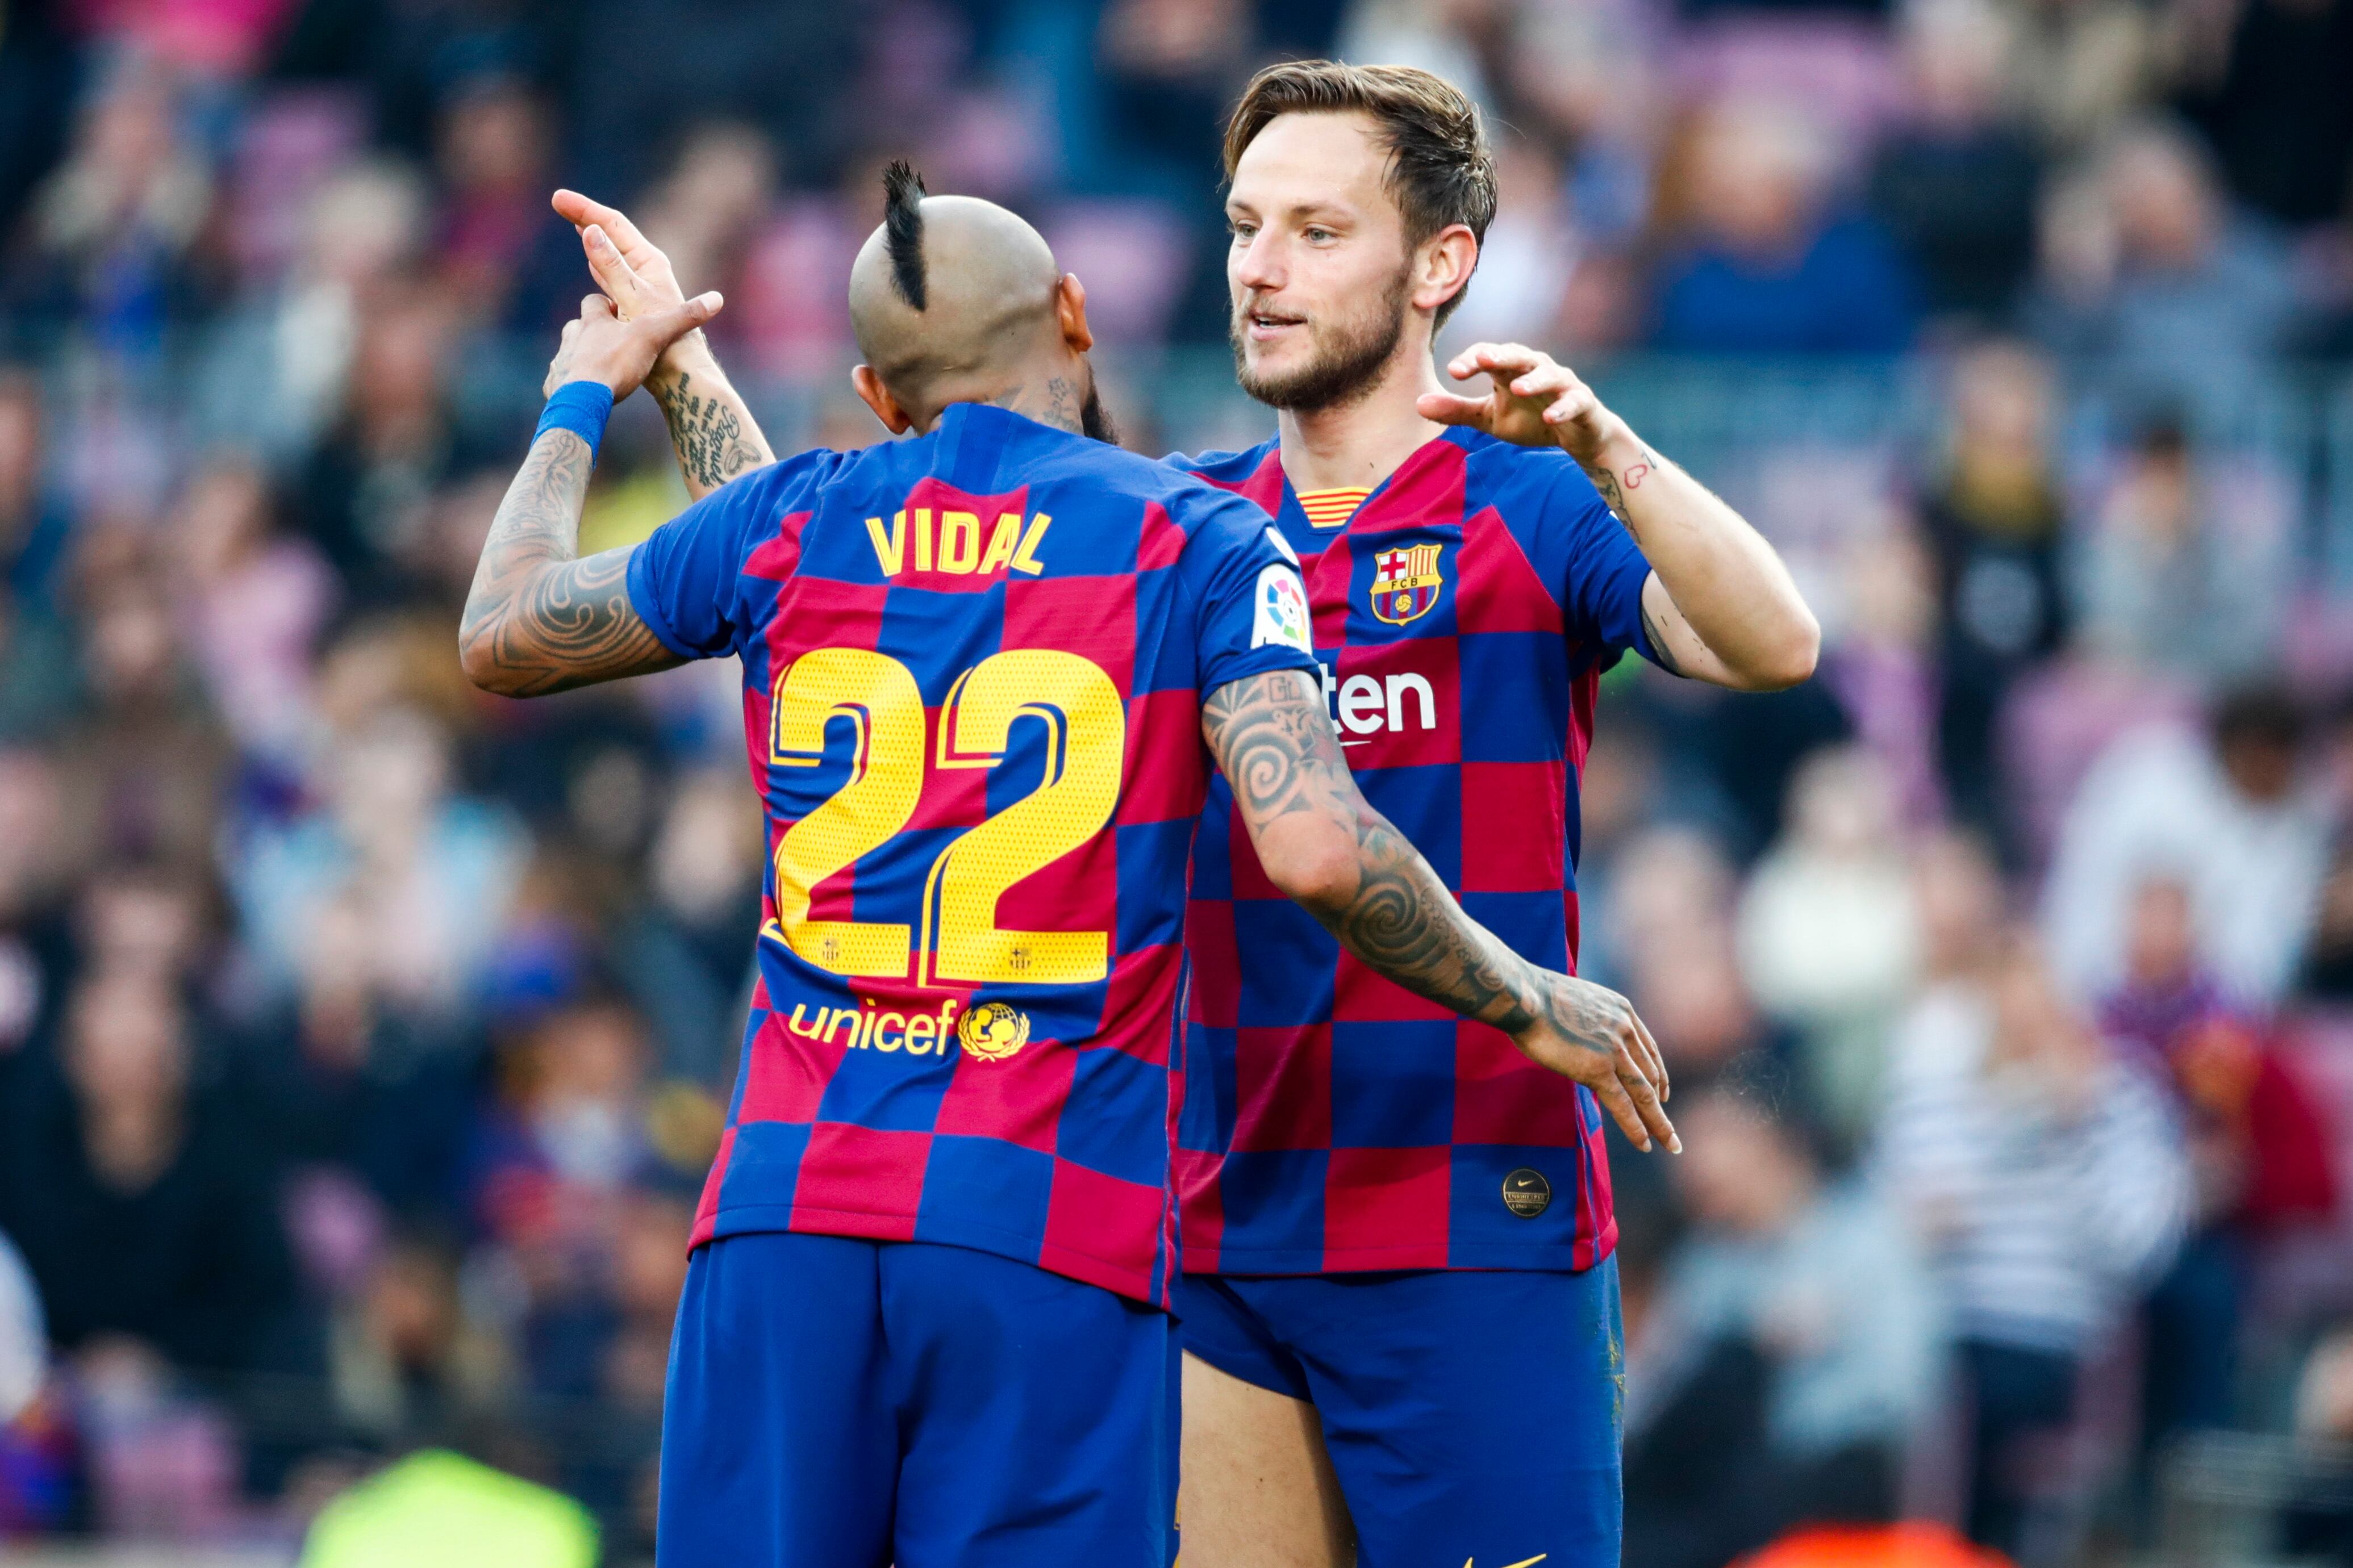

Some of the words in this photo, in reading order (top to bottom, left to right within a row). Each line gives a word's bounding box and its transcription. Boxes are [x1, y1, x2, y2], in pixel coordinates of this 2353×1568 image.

[865, 508, 1053, 577] VIDAL
[1391, 578, 1419, 590] FCB
[760, 647, 1125, 989] 22
[788, 998, 957, 1056] unicef
